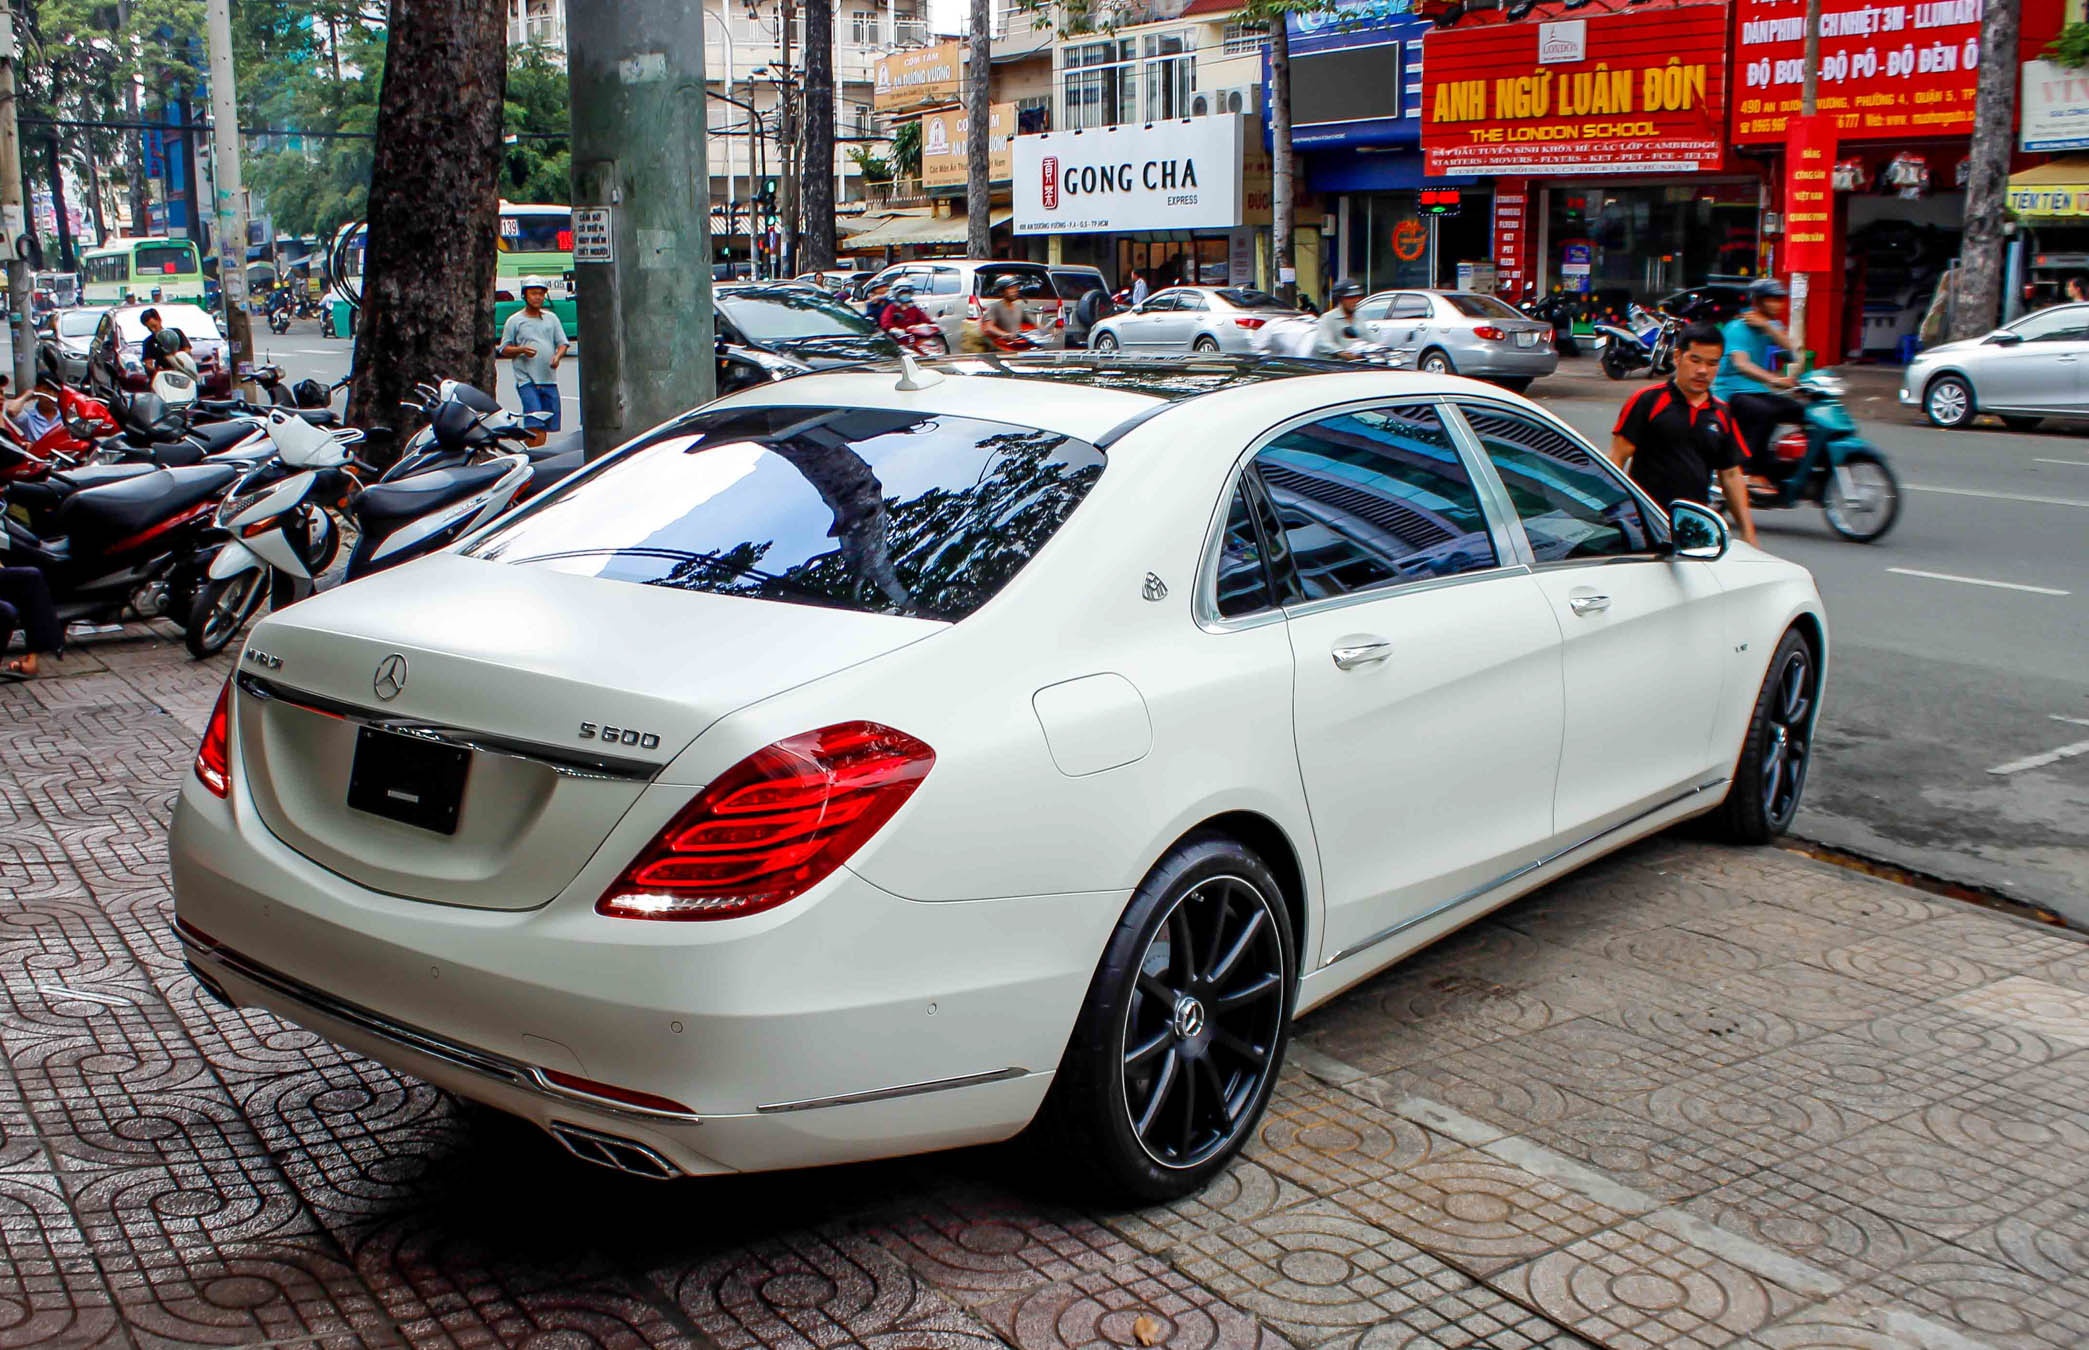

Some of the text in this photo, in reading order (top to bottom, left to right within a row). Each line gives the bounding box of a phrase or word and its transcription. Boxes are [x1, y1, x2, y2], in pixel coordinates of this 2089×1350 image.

[1432, 56, 1706, 123] ANH NGỮ LUÂN ĐÔN
[1470, 121, 1660, 144] THE LONDON SCHOOL
[1645, 141, 1719, 150] CAMBRIDGE
[1432, 158, 1482, 166] STARTERS
[1490, 156, 1532, 164] MOVERS
[1540, 155, 1581, 163] FLYERS
[1684, 151, 1719, 160] IELTS
[1063, 158, 1198, 195] GONG CHA
[1167, 195, 1199, 206] EXPRESS
[503, 220, 517, 235] 139
